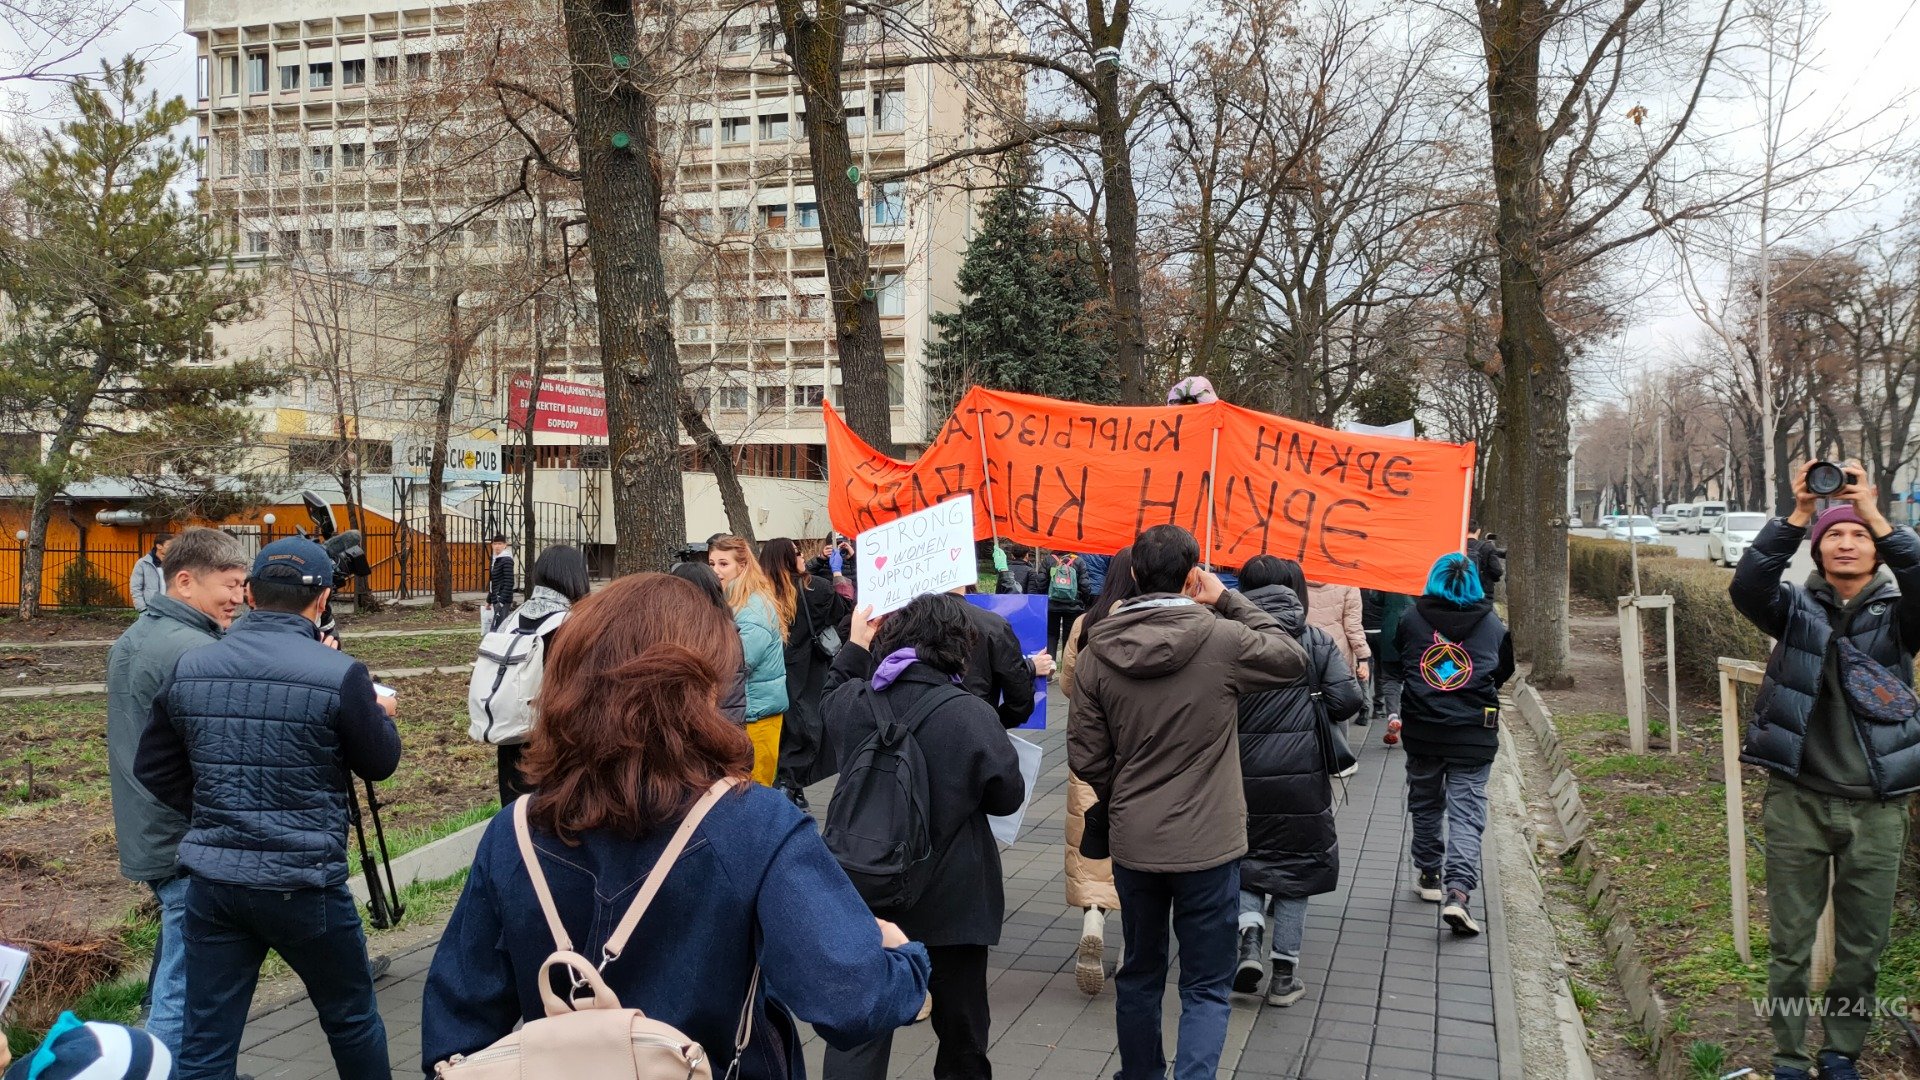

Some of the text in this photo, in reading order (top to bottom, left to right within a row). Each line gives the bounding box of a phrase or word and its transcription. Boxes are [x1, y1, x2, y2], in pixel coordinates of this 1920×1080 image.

[520, 398, 566, 413] БИКЕКТЕГИ
[547, 418, 578, 430] БОРБОРУ
[476, 450, 497, 471] PUB
[865, 502, 963, 556] STRONG
[893, 533, 949, 564] WOMEN
[868, 556, 934, 592] SUPPORT
[884, 567, 959, 606] ALL WOMEN
